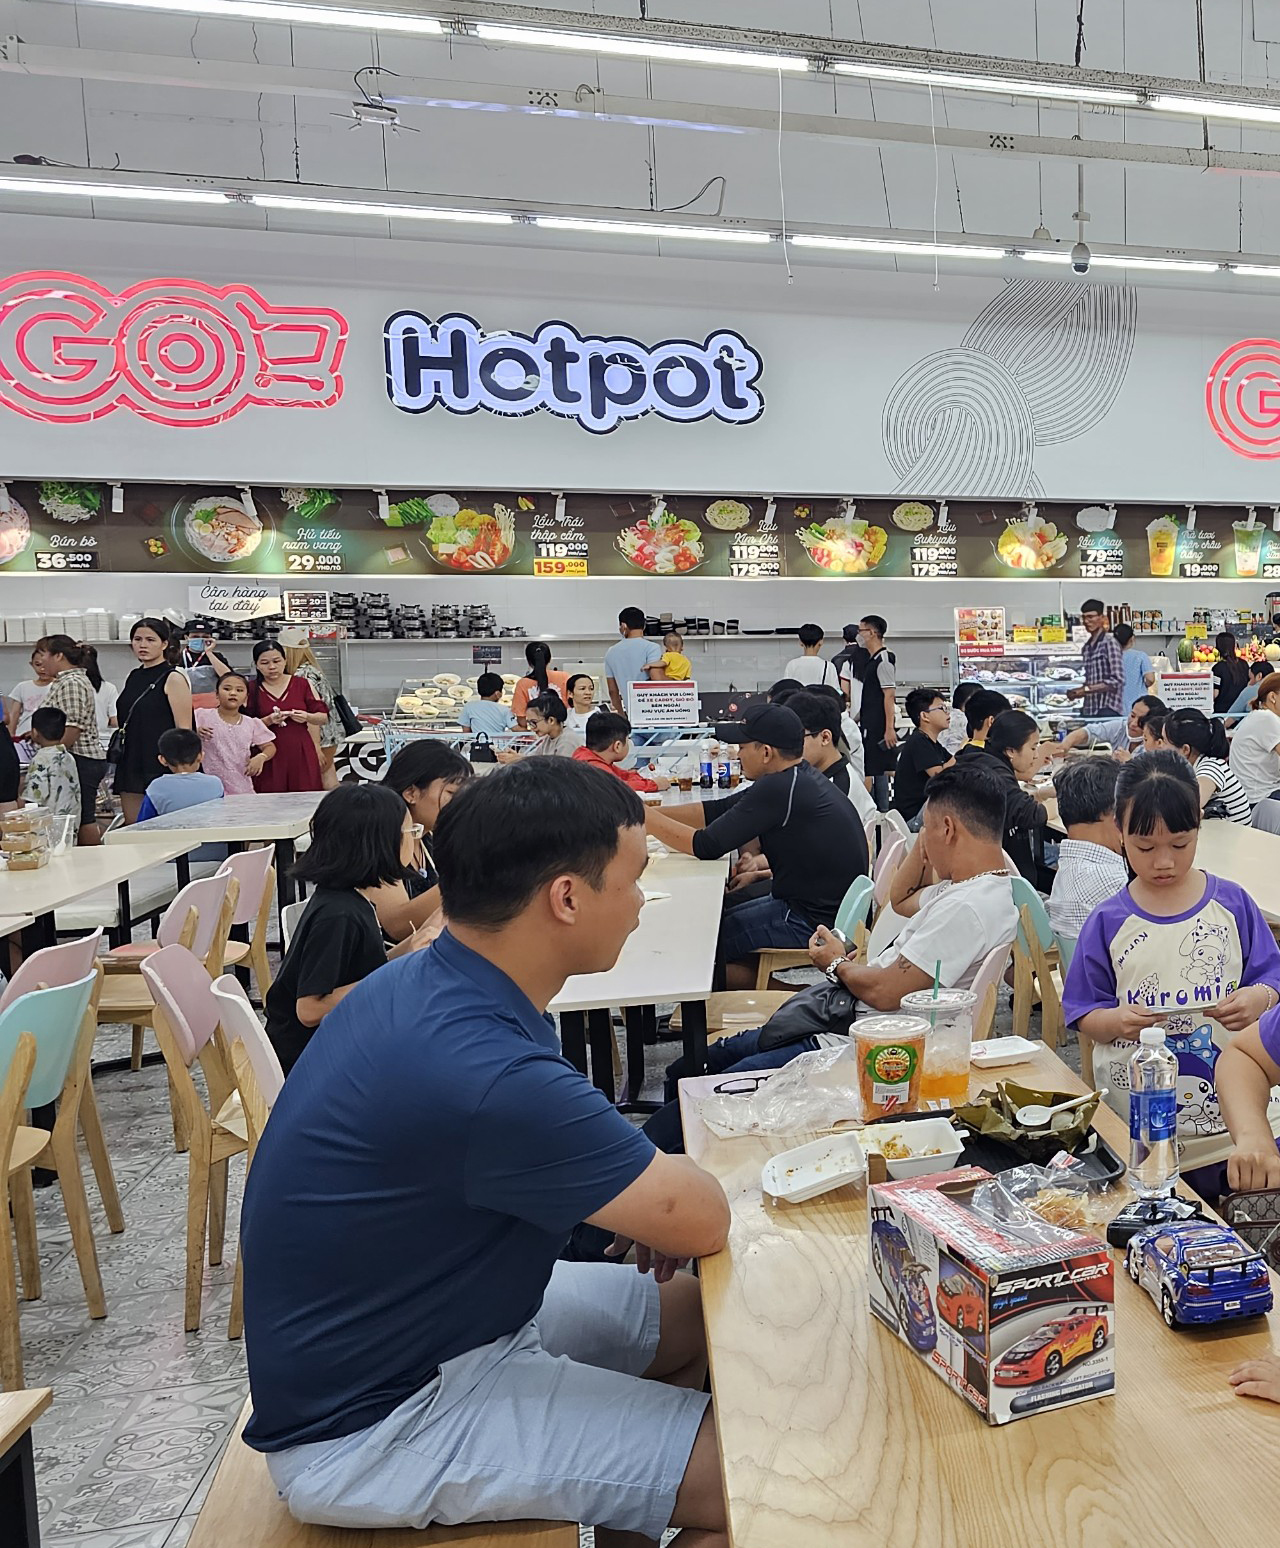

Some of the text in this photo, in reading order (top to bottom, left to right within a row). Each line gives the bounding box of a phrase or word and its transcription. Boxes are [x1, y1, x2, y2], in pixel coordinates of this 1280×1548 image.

[393, 322, 757, 426] Hotpot
[532, 513, 556, 528] Lẩu
[50, 535, 97, 548] Bún bò
[296, 528, 316, 541] Hủ
[530, 528, 586, 542] thập cẩm
[734, 532, 779, 546] Kim Chi
[913, 533, 958, 547] Sukiyaki
[1076, 534, 1123, 549] Lẩu Chay
[312, 540, 342, 553] vang
[200, 585, 269, 602] Cân hàng
[208, 600, 261, 615] tại đây
[1127, 977, 1221, 1007] Kuromi
[992, 1270, 1070, 1297] SPORT
[931, 1348, 968, 1390] SPORT
